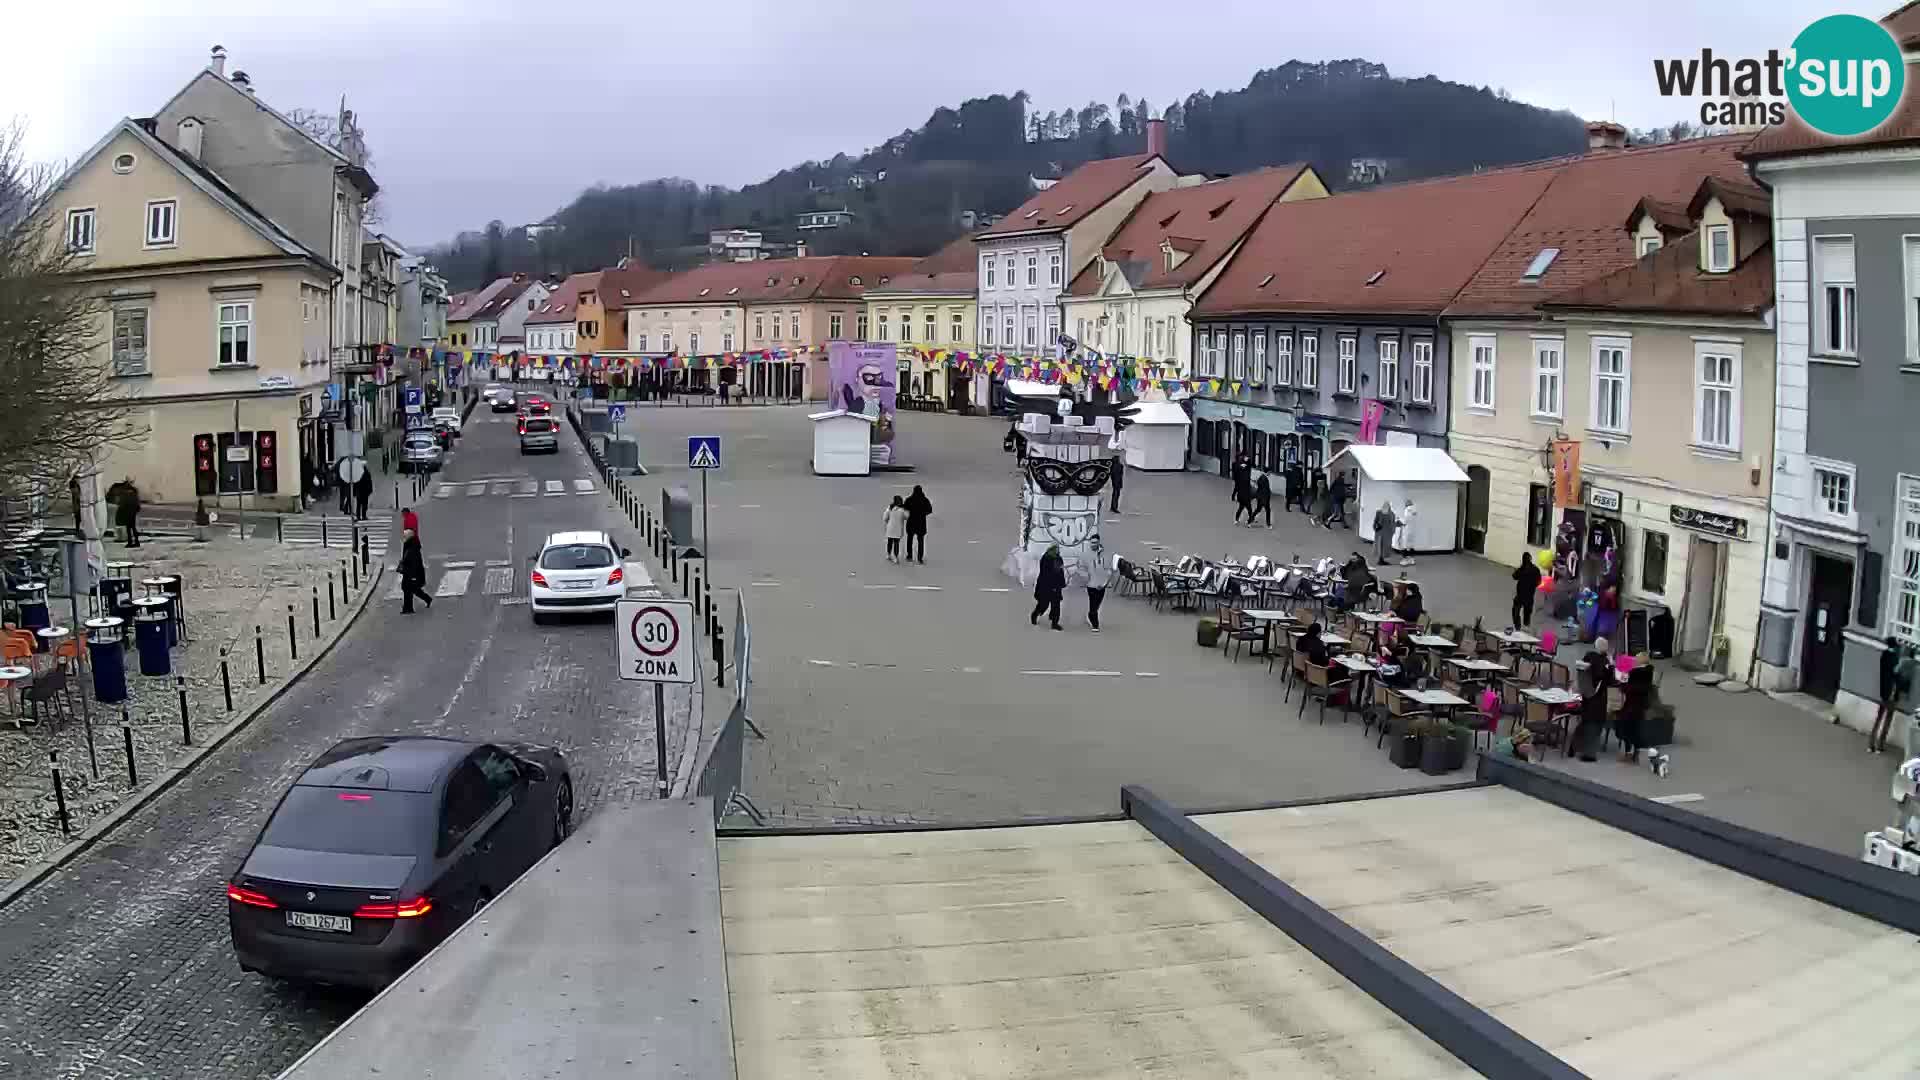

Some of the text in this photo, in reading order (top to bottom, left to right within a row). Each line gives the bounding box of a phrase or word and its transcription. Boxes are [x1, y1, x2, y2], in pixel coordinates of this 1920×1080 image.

[409, 391, 417, 402] P
[644, 622, 668, 643] 30
[634, 659, 678, 677] ZONA
